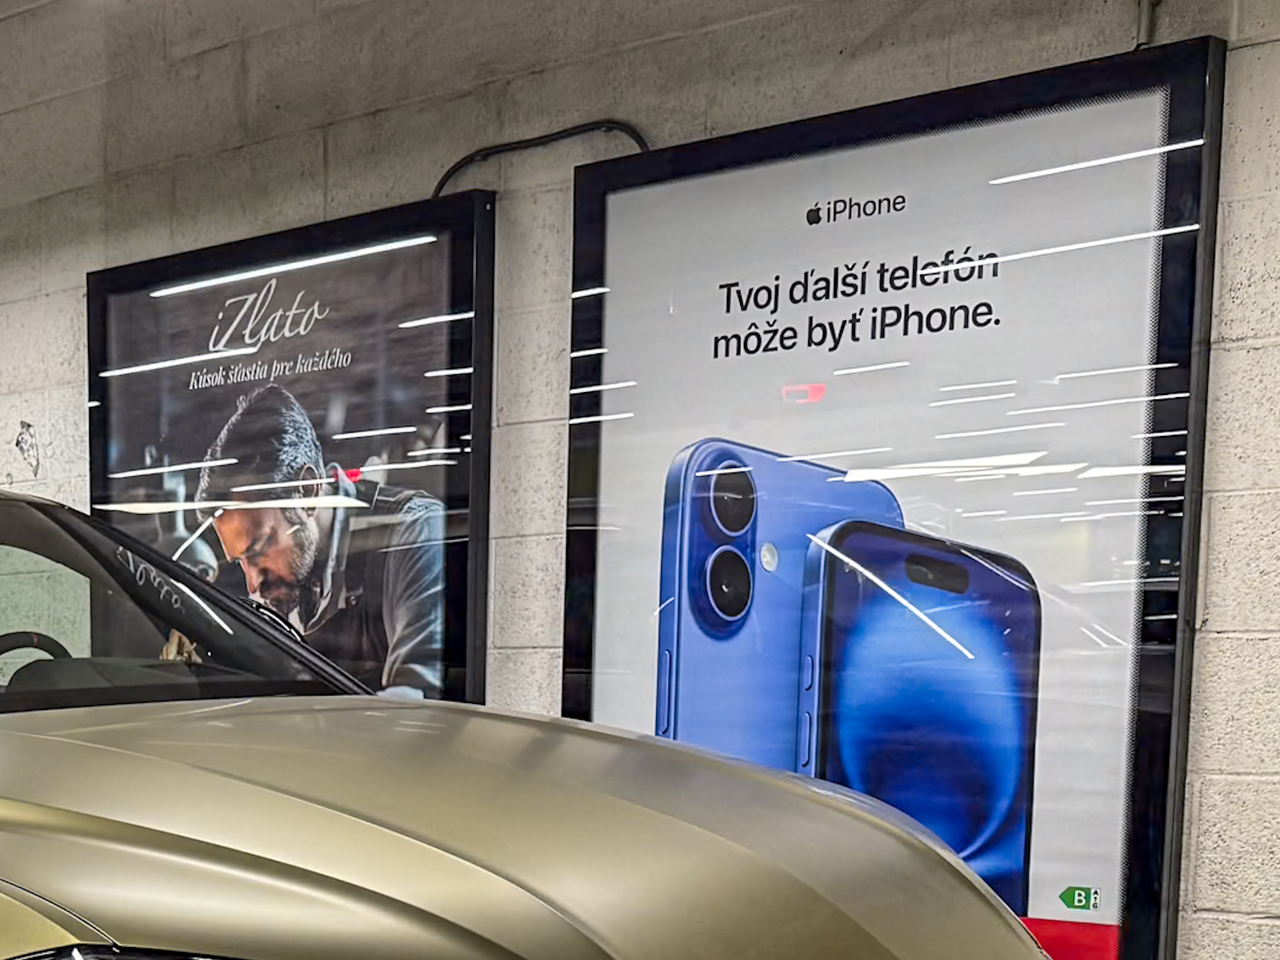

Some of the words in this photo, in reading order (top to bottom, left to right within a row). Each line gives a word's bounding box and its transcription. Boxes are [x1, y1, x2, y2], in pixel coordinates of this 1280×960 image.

[826, 195, 907, 223] iPhone
[719, 275, 780, 315] Tvoj
[789, 261, 870, 304] ďalší
[877, 246, 1000, 293] telefón
[207, 277, 330, 353] iZlato
[713, 319, 798, 359] môže
[807, 307, 864, 352] byť
[871, 301, 1001, 340] iPhone.
[189, 366, 226, 390] Kúsok
[227, 361, 267, 384] šťastia
[270, 359, 294, 381] pre
[295, 347, 352, 374] každého
[1074, 889, 1087, 906] B
